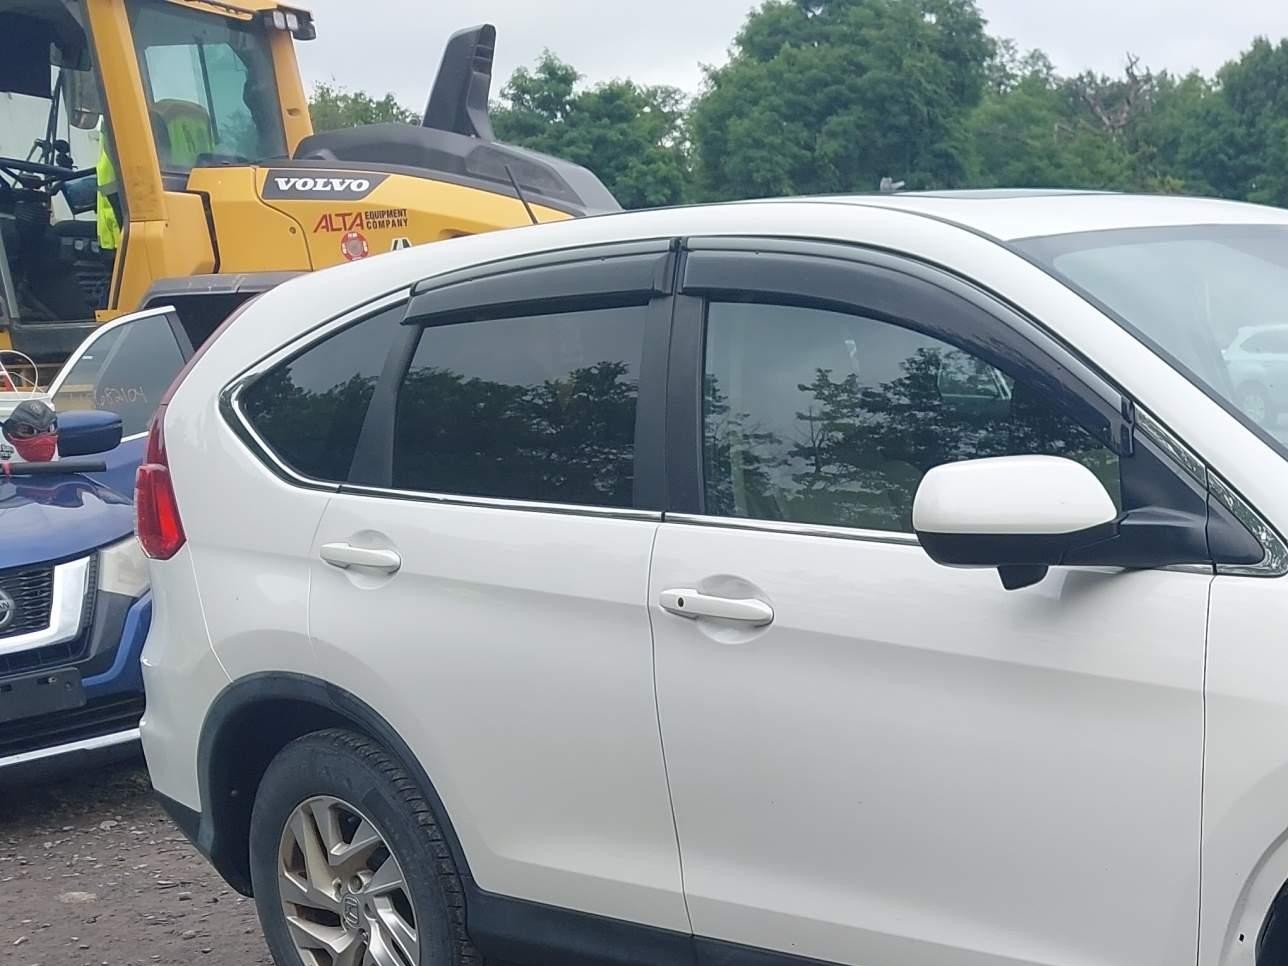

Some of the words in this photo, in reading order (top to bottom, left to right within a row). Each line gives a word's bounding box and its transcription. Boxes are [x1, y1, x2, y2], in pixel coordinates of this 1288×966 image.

[274, 177, 370, 192] VOLVO
[364, 208, 408, 220] EQUIPMENT
[313, 212, 364, 233] ALTA
[366, 218, 408, 230] COMPANY
